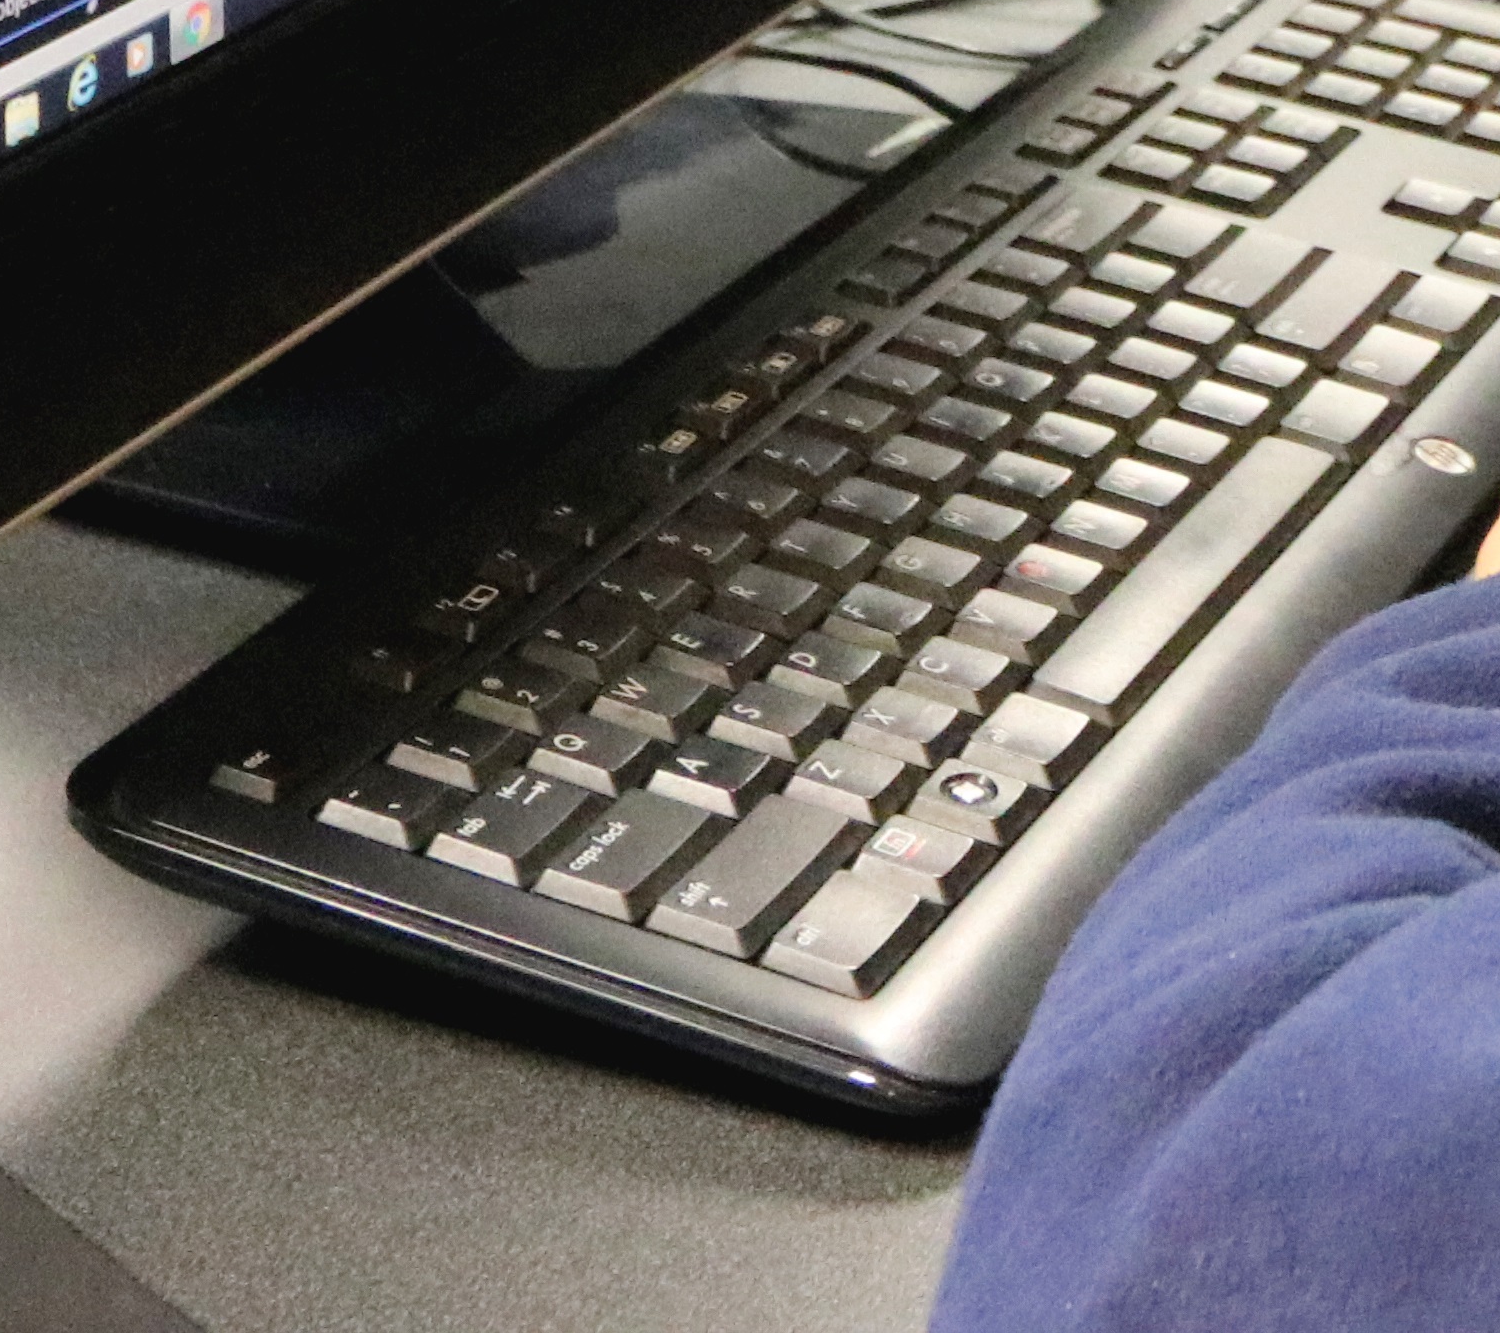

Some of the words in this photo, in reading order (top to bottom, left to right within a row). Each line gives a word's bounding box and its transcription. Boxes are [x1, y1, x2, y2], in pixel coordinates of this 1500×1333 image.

[670, 632, 702, 650] E
[787, 651, 818, 669] D
[918, 656, 950, 675] C
[610, 675, 649, 702] W
[731, 702, 762, 722] S
[863, 706, 896, 727] X
[552, 731, 589, 753] Q
[675, 751, 712, 776] A
[808, 759, 843, 780] Z
[456, 815, 488, 839] tab
[568, 843, 605, 873] caps
[598, 819, 632, 847] lock
[677, 880, 711, 909] shift
